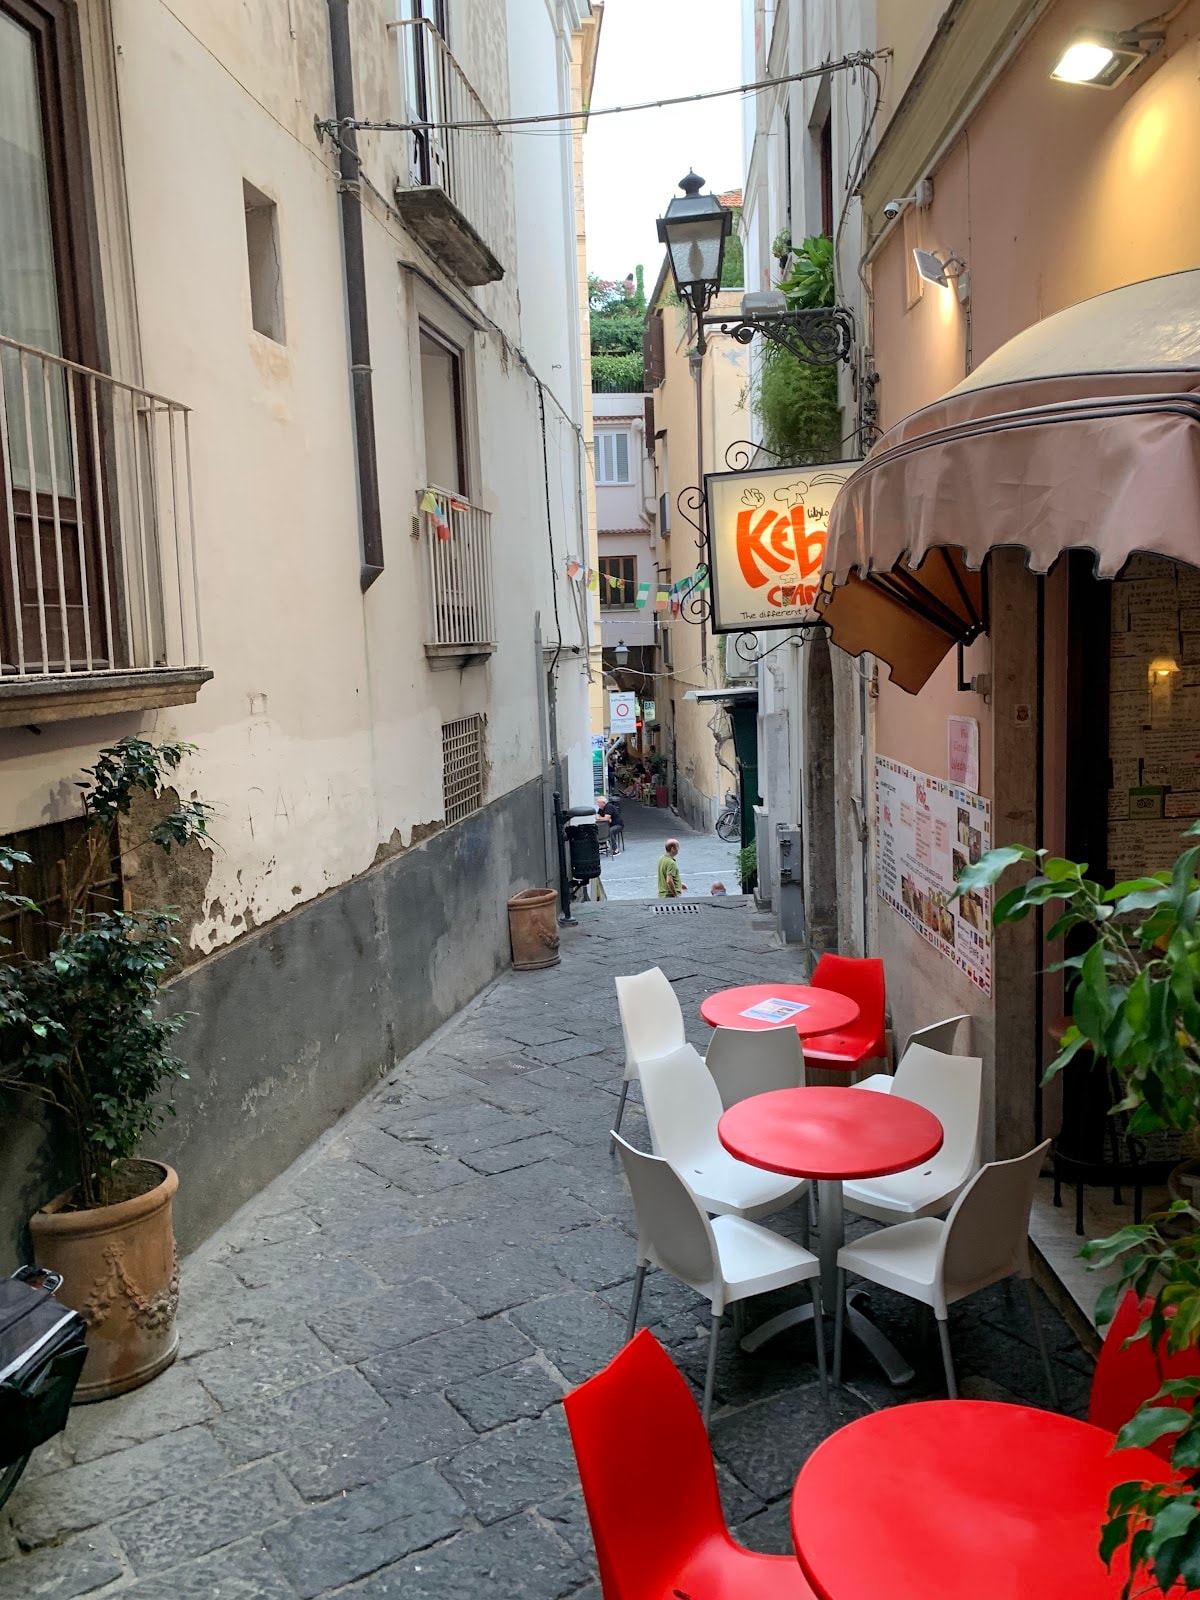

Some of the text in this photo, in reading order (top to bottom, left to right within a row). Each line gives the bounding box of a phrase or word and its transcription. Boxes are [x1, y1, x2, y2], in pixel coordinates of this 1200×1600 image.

[736, 505, 828, 588] Keb
[740, 611, 757, 620] The
[759, 608, 802, 619] different
